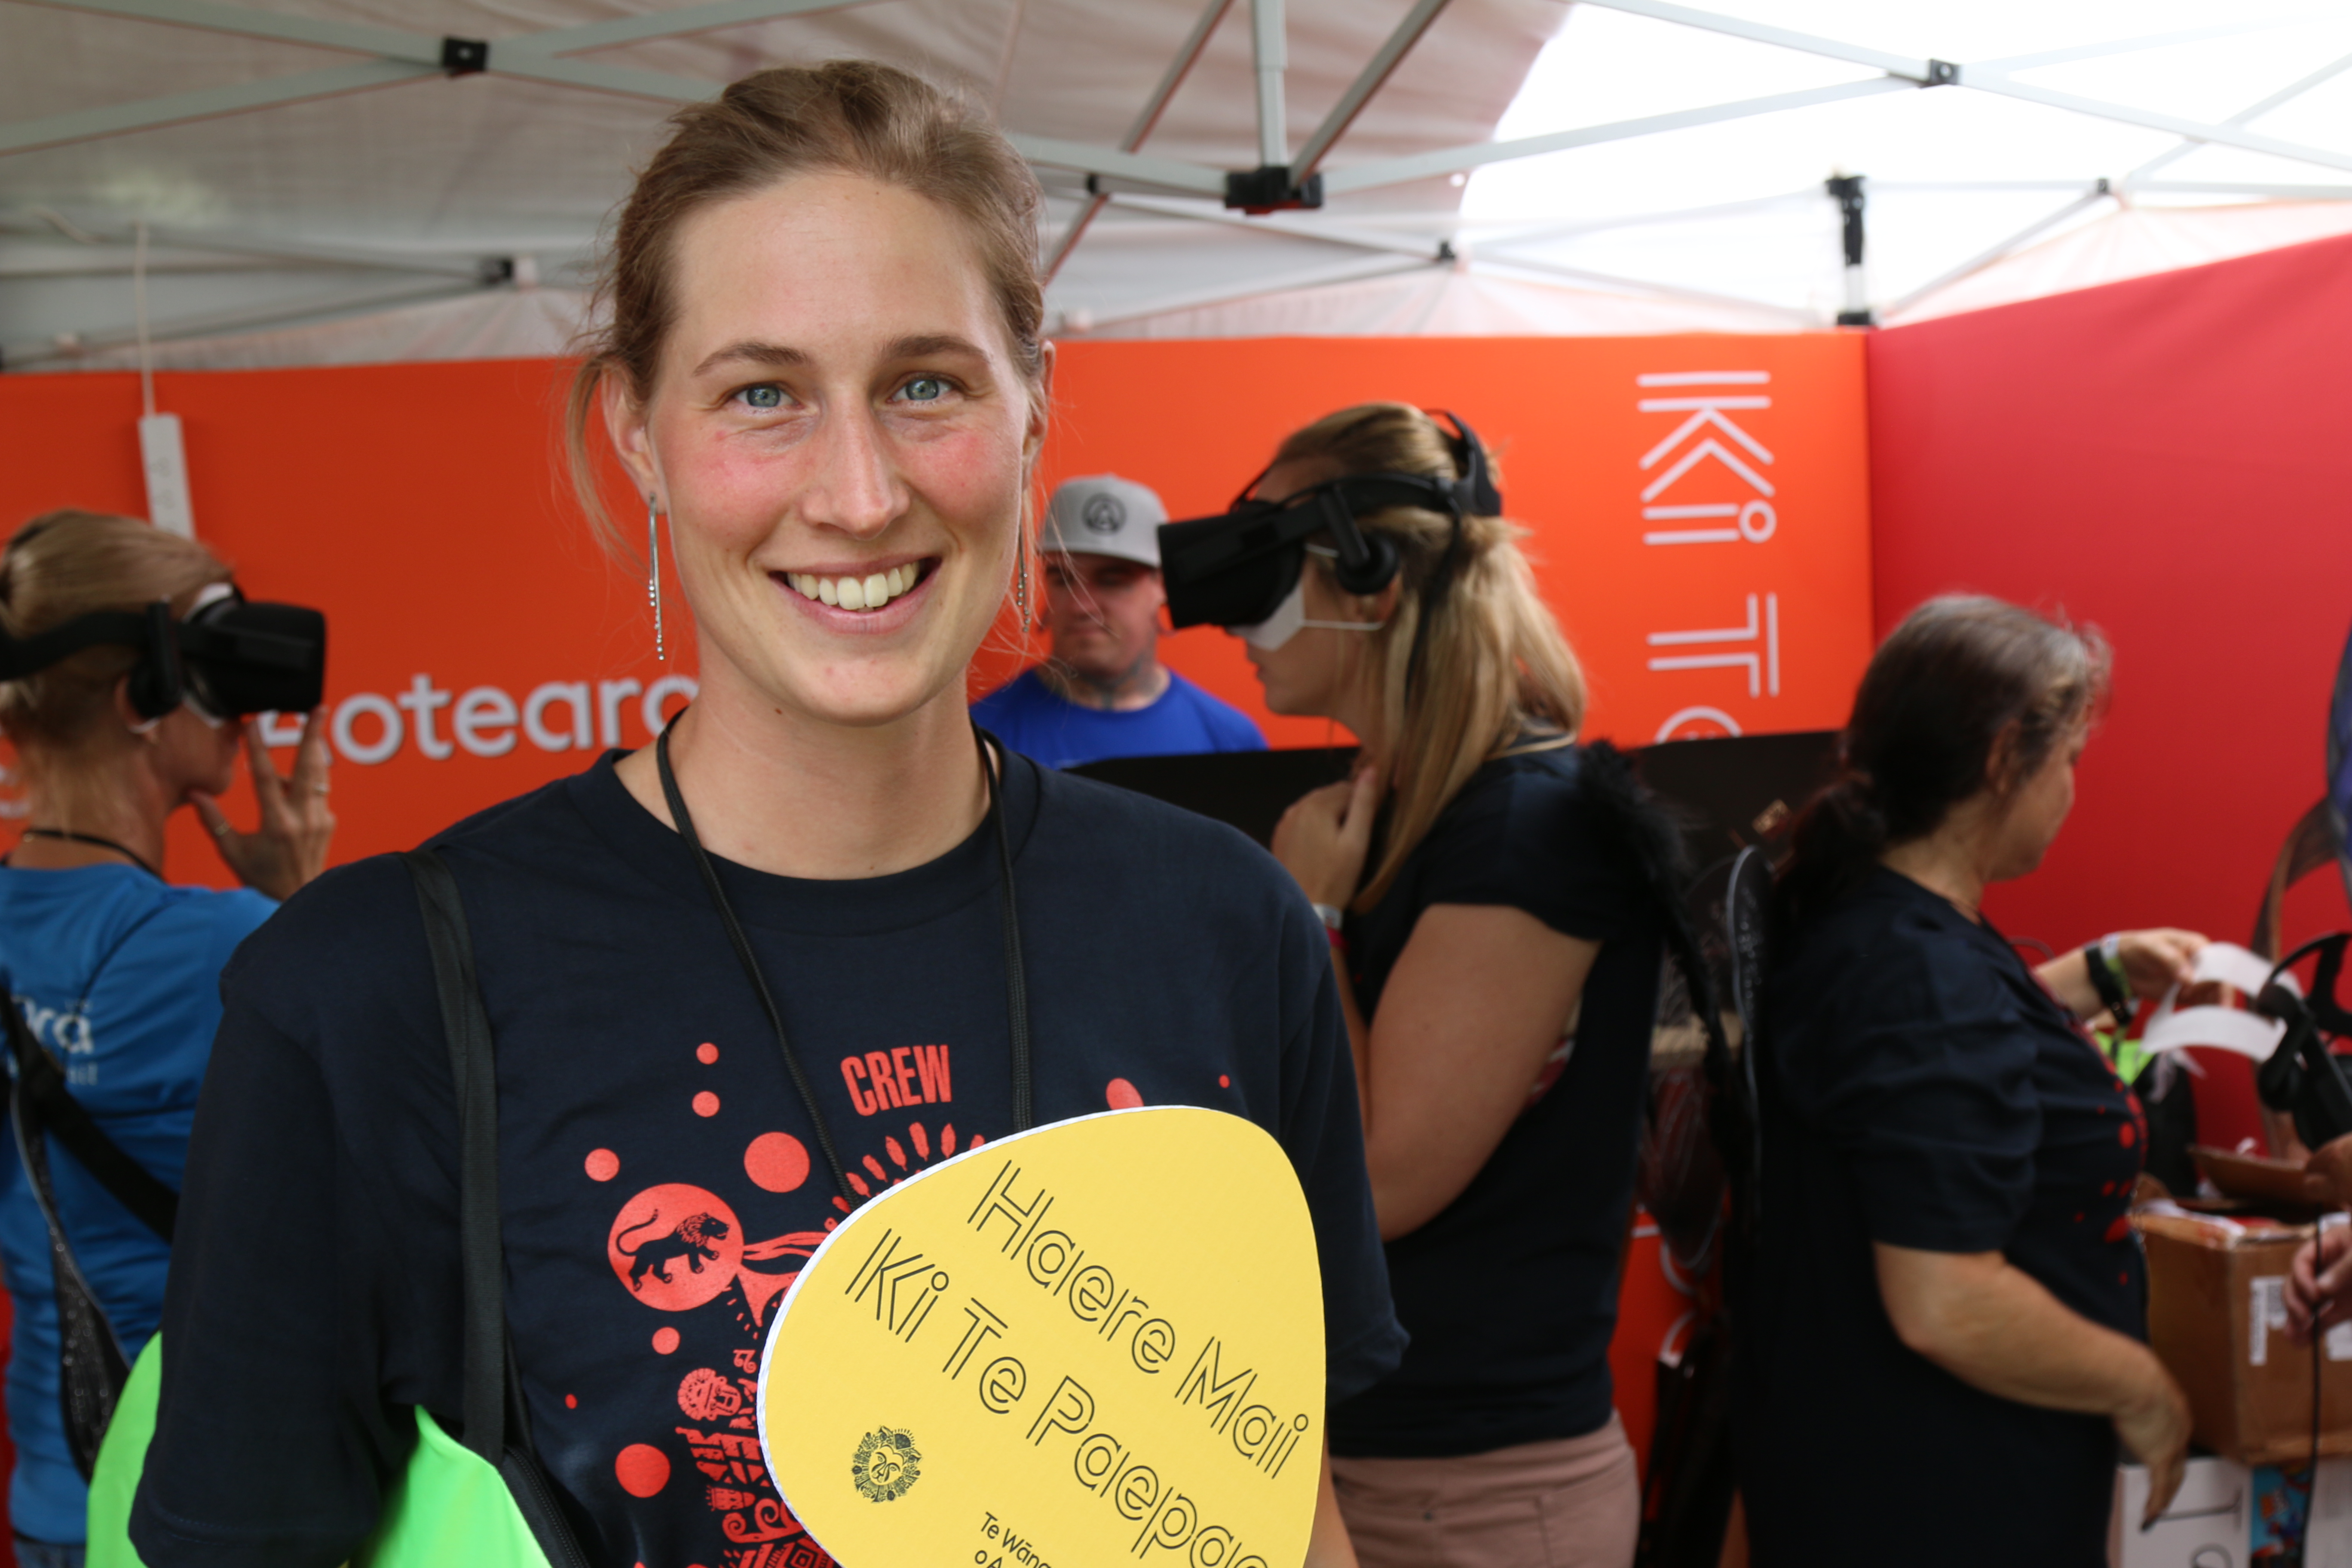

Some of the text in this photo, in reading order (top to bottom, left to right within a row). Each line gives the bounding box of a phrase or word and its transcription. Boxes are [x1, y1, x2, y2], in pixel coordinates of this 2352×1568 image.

[1637, 371, 1777, 545] Ki
[840, 1044, 952, 1116] CREW
[845, 1228, 1268, 1568] Ki Te Paepa
[967, 1160, 1309, 1479] Haere Mai
[981, 1511, 999, 1539] Te
